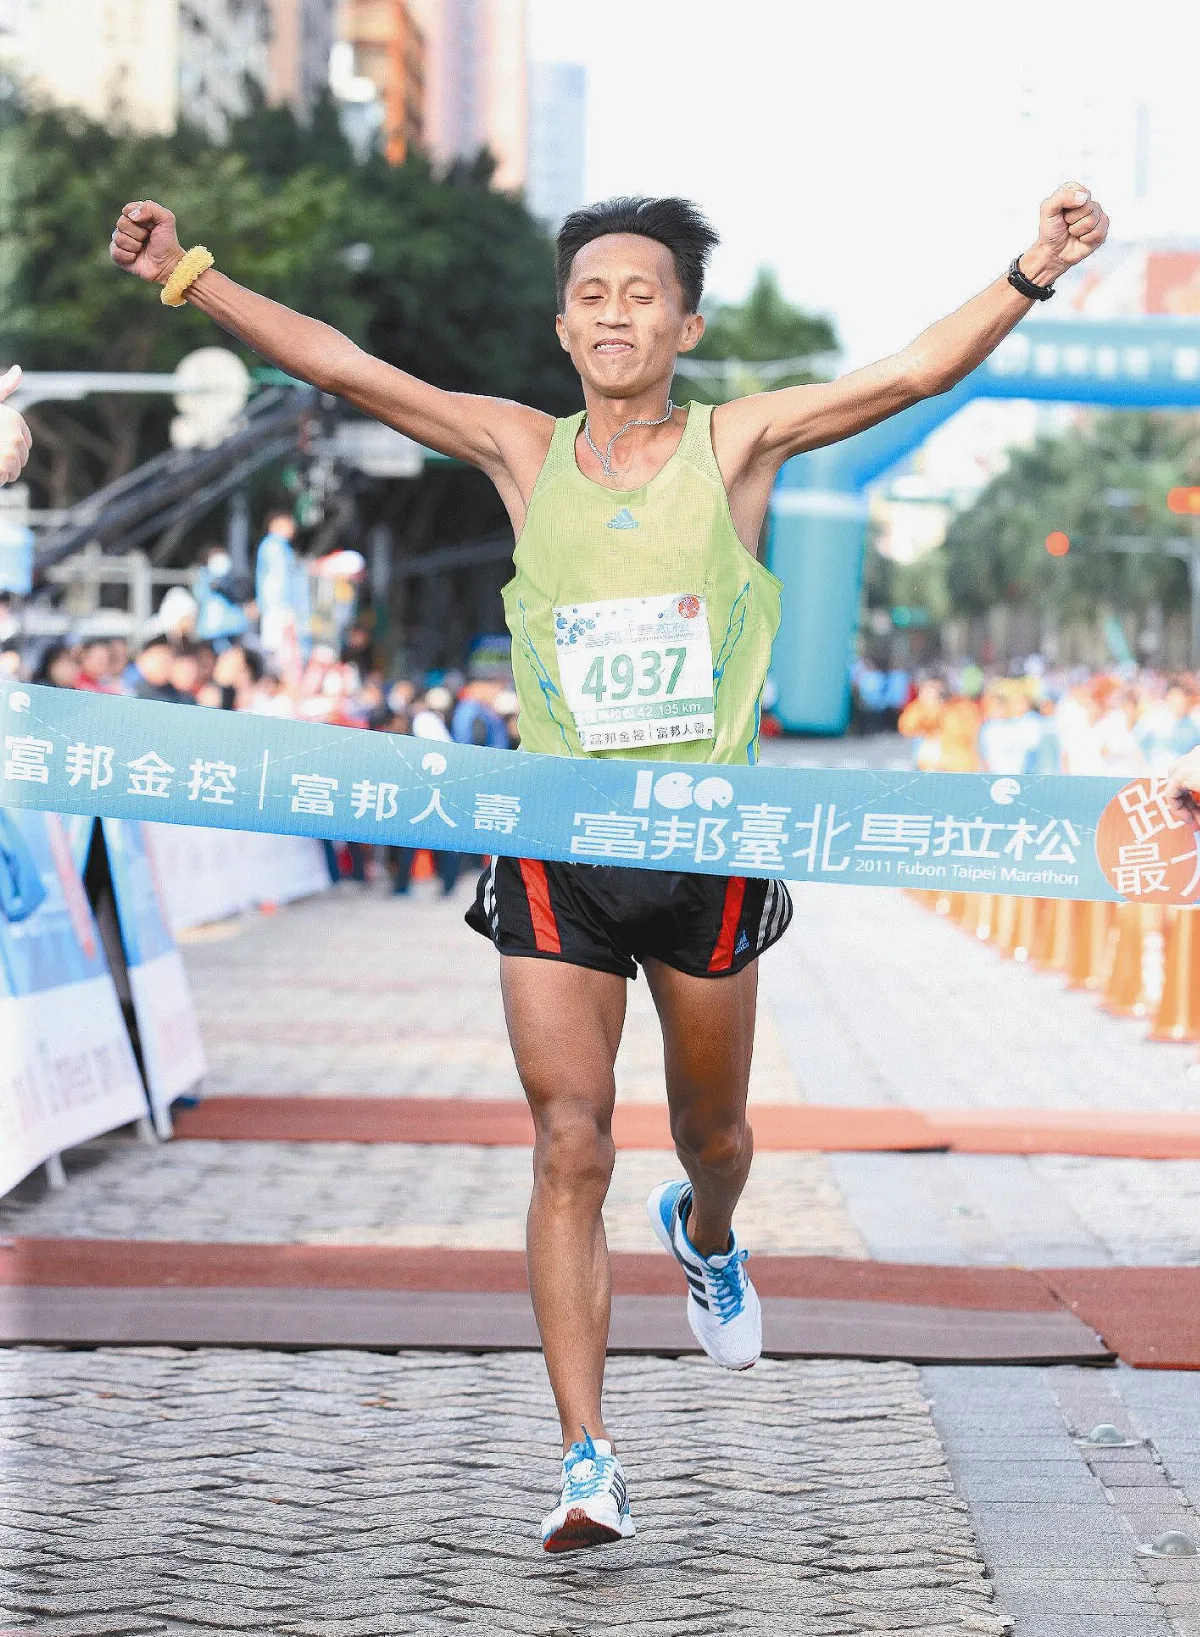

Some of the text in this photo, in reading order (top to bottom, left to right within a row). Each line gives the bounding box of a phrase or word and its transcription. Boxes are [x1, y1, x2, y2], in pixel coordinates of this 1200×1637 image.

[581, 647, 687, 703] 4937
[682, 702, 701, 713] km
[3, 734, 522, 834] 富邦金控 富邦人壽
[570, 803, 1082, 872] 富邦臺北馬拉松
[855, 859, 1079, 886] 2011 Fubon Taipei Marathon
